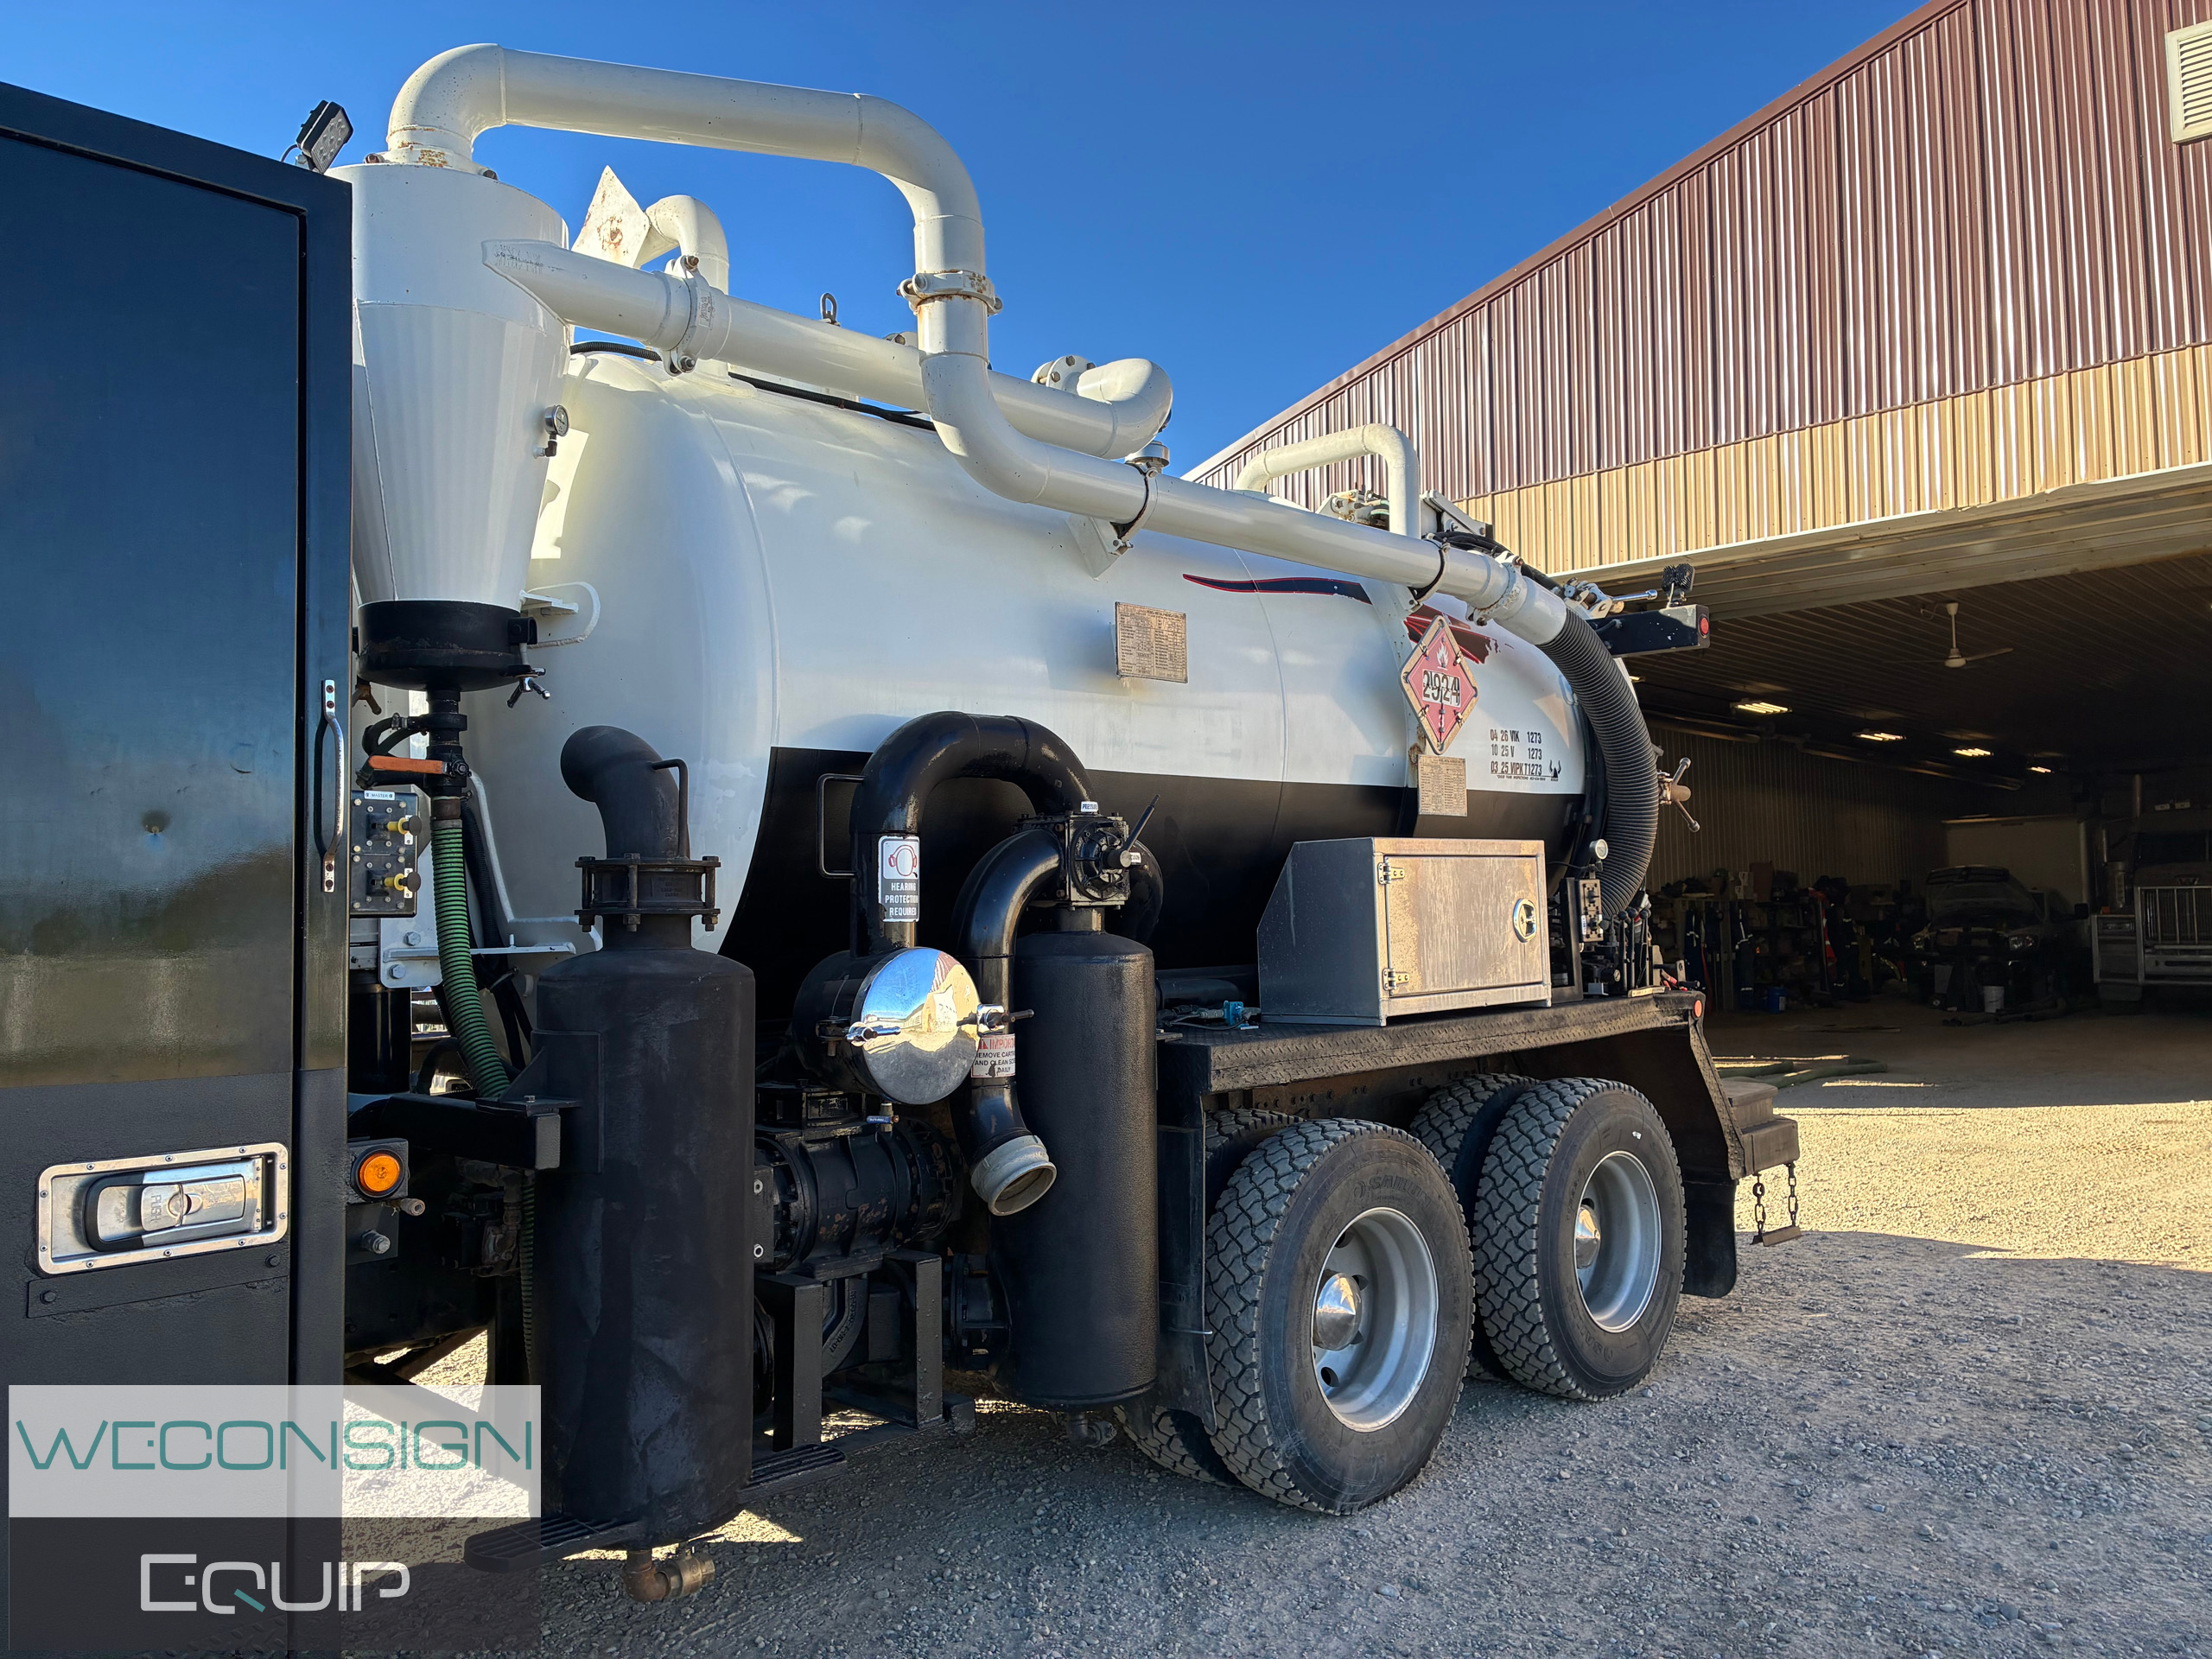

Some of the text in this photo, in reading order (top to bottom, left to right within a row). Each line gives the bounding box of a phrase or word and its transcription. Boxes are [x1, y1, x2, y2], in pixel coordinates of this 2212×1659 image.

[1423, 671, 1459, 703] 2924
[1500, 729, 1509, 742] 26
[1527, 731, 1542, 744] 1273
[1491, 743, 1542, 760] 10 25 V 1273
[1491, 760, 1498, 773] 03
[1501, 761, 1509, 774] 25
[891, 882, 917, 892] HEARING
[885, 894, 918, 904] PROTECTION
[889, 907, 917, 917] REQUIRED
[150, 1194, 162, 1222] PUSH
